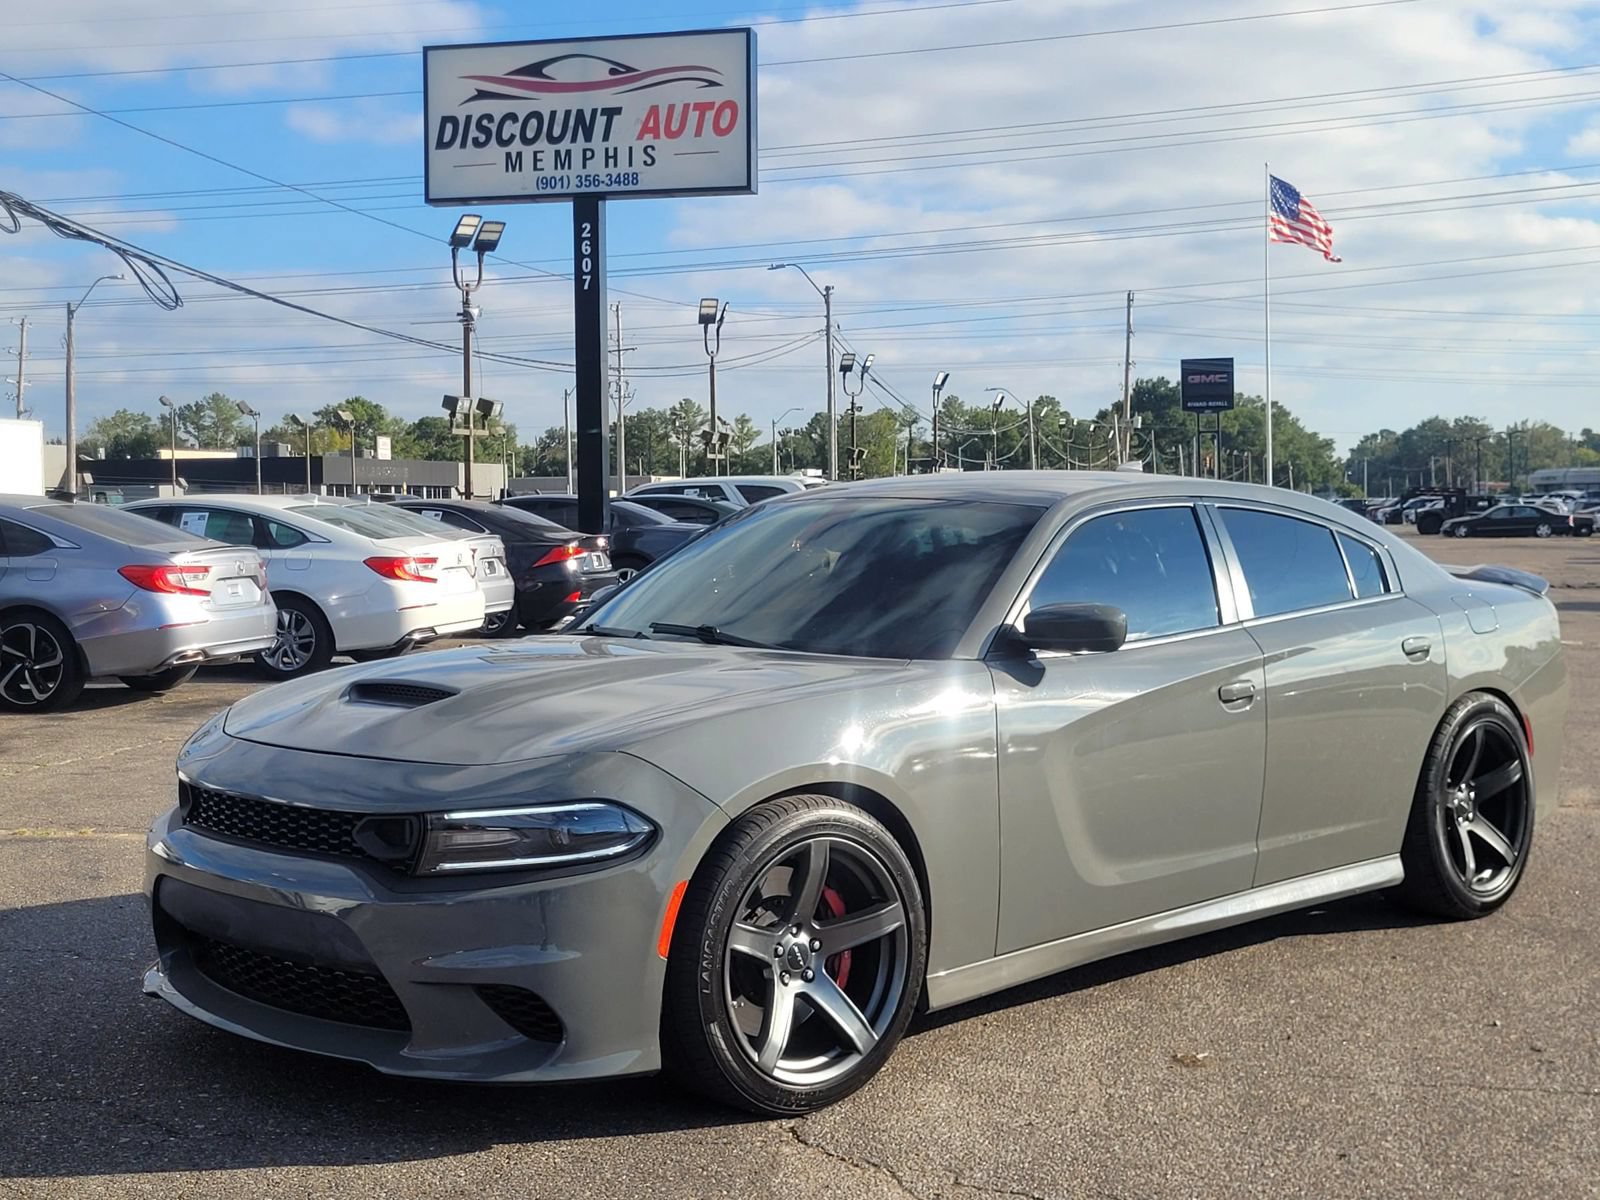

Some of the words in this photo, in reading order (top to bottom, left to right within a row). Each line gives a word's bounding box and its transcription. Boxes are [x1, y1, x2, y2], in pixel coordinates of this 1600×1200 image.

[435, 106, 623, 150] DISCOUNT
[636, 99, 739, 141] AUTO
[505, 145, 657, 173] MEMPHIS
[535, 174, 571, 191] (901)
[575, 172, 640, 189] 356-3488
[581, 223, 592, 290] 2607
[1187, 374, 1228, 383] GMC
